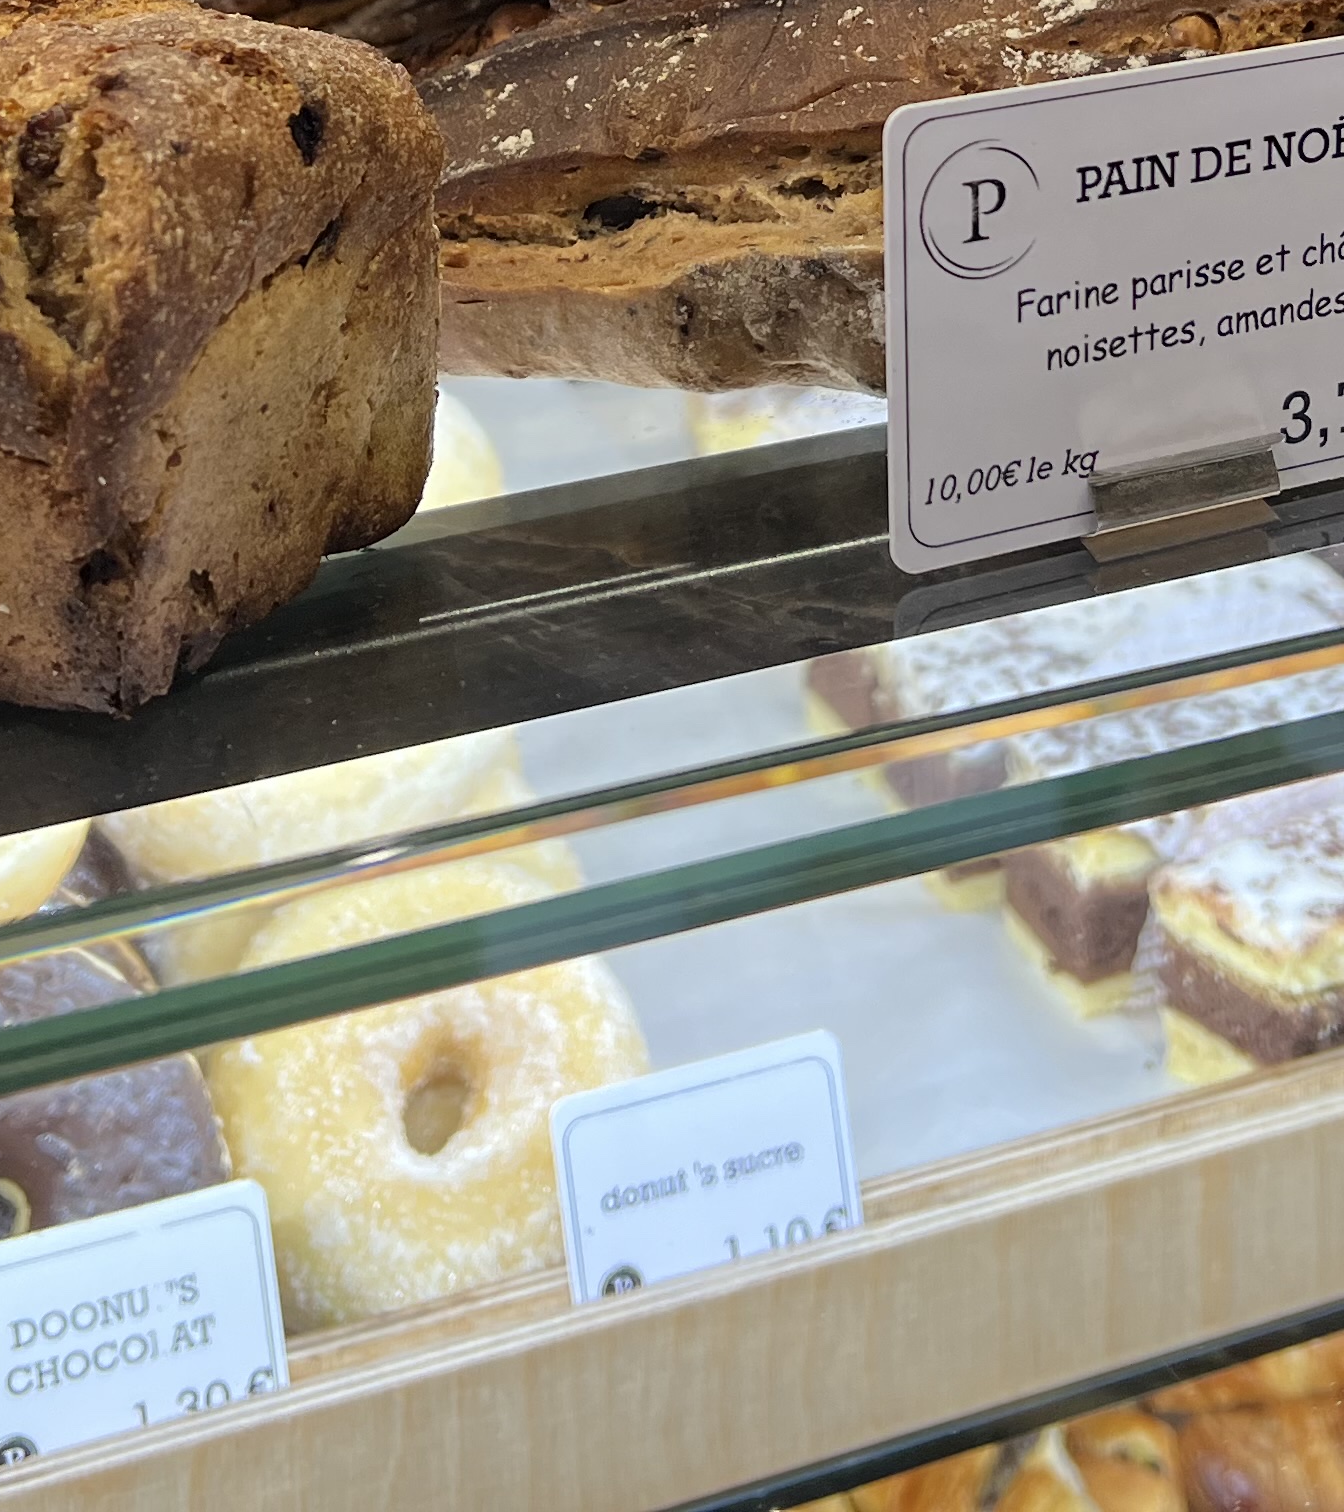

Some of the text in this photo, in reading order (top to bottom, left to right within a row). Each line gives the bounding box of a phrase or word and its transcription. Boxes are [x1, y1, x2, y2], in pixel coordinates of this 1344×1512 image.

[1076, 150, 1180, 204] PAIN
[1190, 138, 1253, 184] DE
[961, 178, 1006, 244] P
[1016, 280, 1120, 323] Farine
[1131, 259, 1246, 310] parisse
[1255, 244, 1291, 276] et
[1046, 318, 1206, 371] noisettes,
[924, 448, 1100, 505] 10,00€ le kg
[600, 1168, 689, 1213] donut
[724, 1217, 813, 1260] 110
